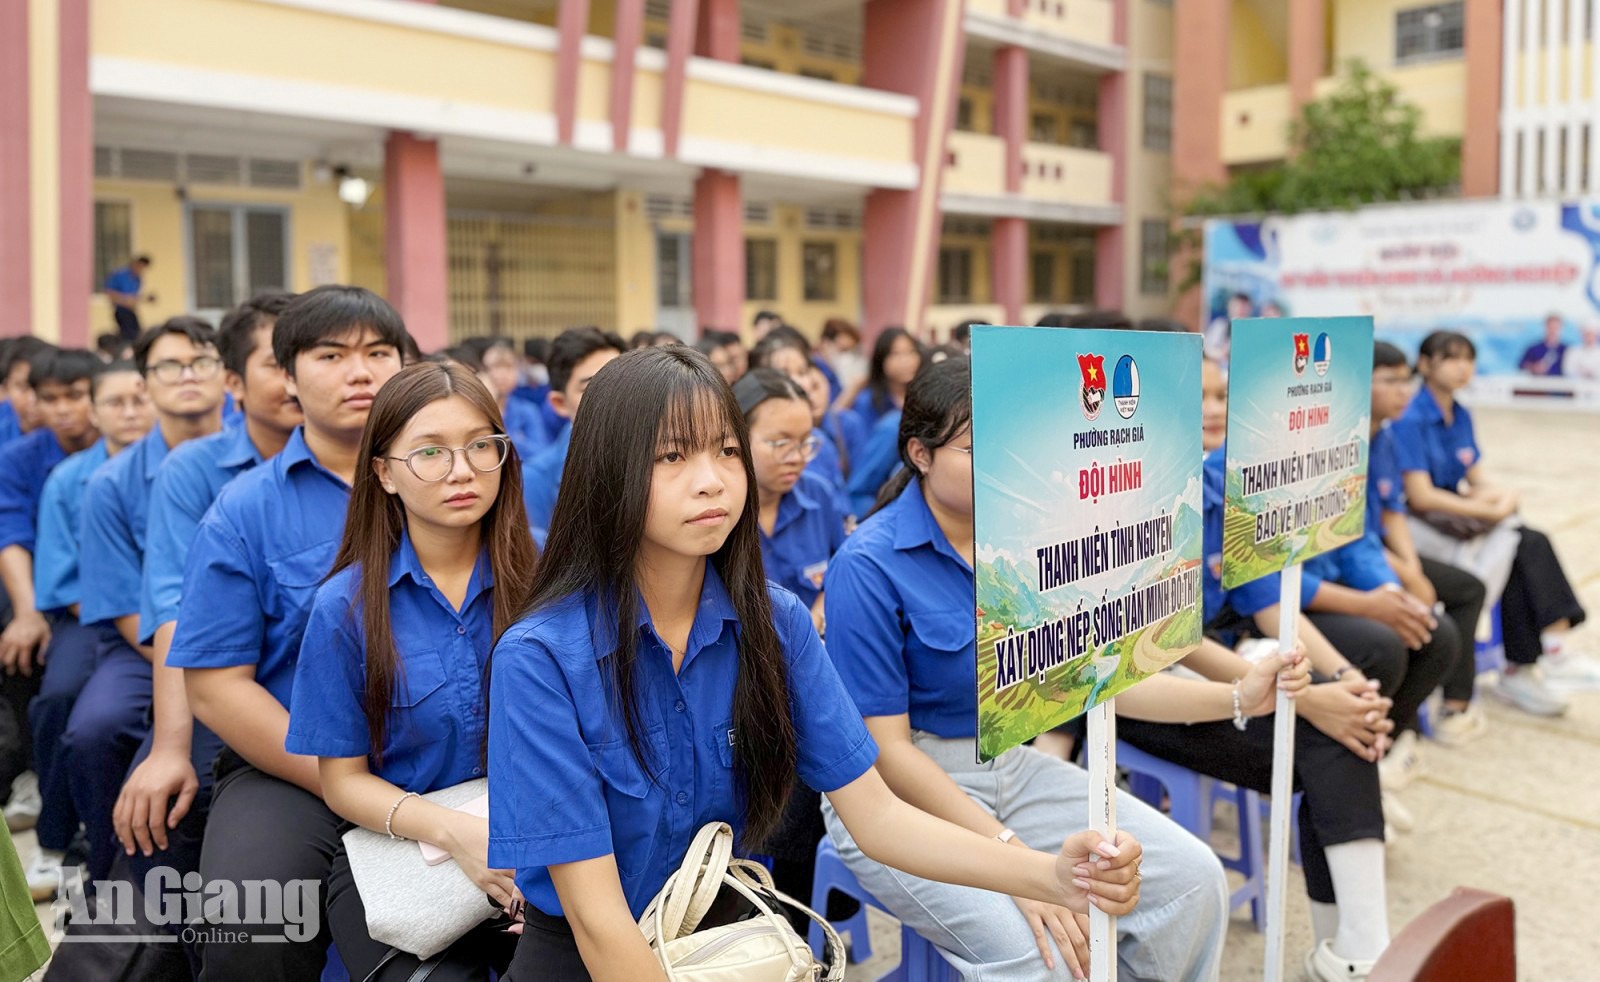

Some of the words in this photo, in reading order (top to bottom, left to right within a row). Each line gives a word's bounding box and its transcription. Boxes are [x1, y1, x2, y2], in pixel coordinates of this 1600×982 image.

[1073, 427, 1108, 450] PHƯỜNG
[1110, 427, 1131, 448] RẠCH
[1132, 423, 1145, 442] GIÁ
[1289, 406, 1305, 434] ĐỘI
[1308, 403, 1329, 428] HÌNH
[1079, 461, 1105, 504] ĐỘI
[1109, 457, 1142, 494] HÌNH
[1242, 461, 1278, 496] THANH
[1280, 450, 1304, 486] NIÊN
[1306, 446, 1327, 479] TÌNH
[1256, 502, 1278, 542] BẢO
[1280, 500, 1292, 538] VỆ
[1294, 494, 1312, 530] MÔI
[1037, 539, 1079, 592] THANH
[1081, 525, 1109, 579] NIÊN
[1111, 520, 1135, 569] TÌNH
[1136, 509, 1173, 561] NGUYỆN
[995, 627, 1025, 689] XÂY
[1028, 620, 1064, 681] DỰNG
[1066, 599, 1090, 660] NẾP
[1094, 588, 1123, 648] SỐNG
[1124, 584, 1144, 634] VĂN
[1146, 580, 1170, 624] MINH
[1171, 568, 1182, 613] ĐÔ
[1183, 569, 1196, 613] THỊ
